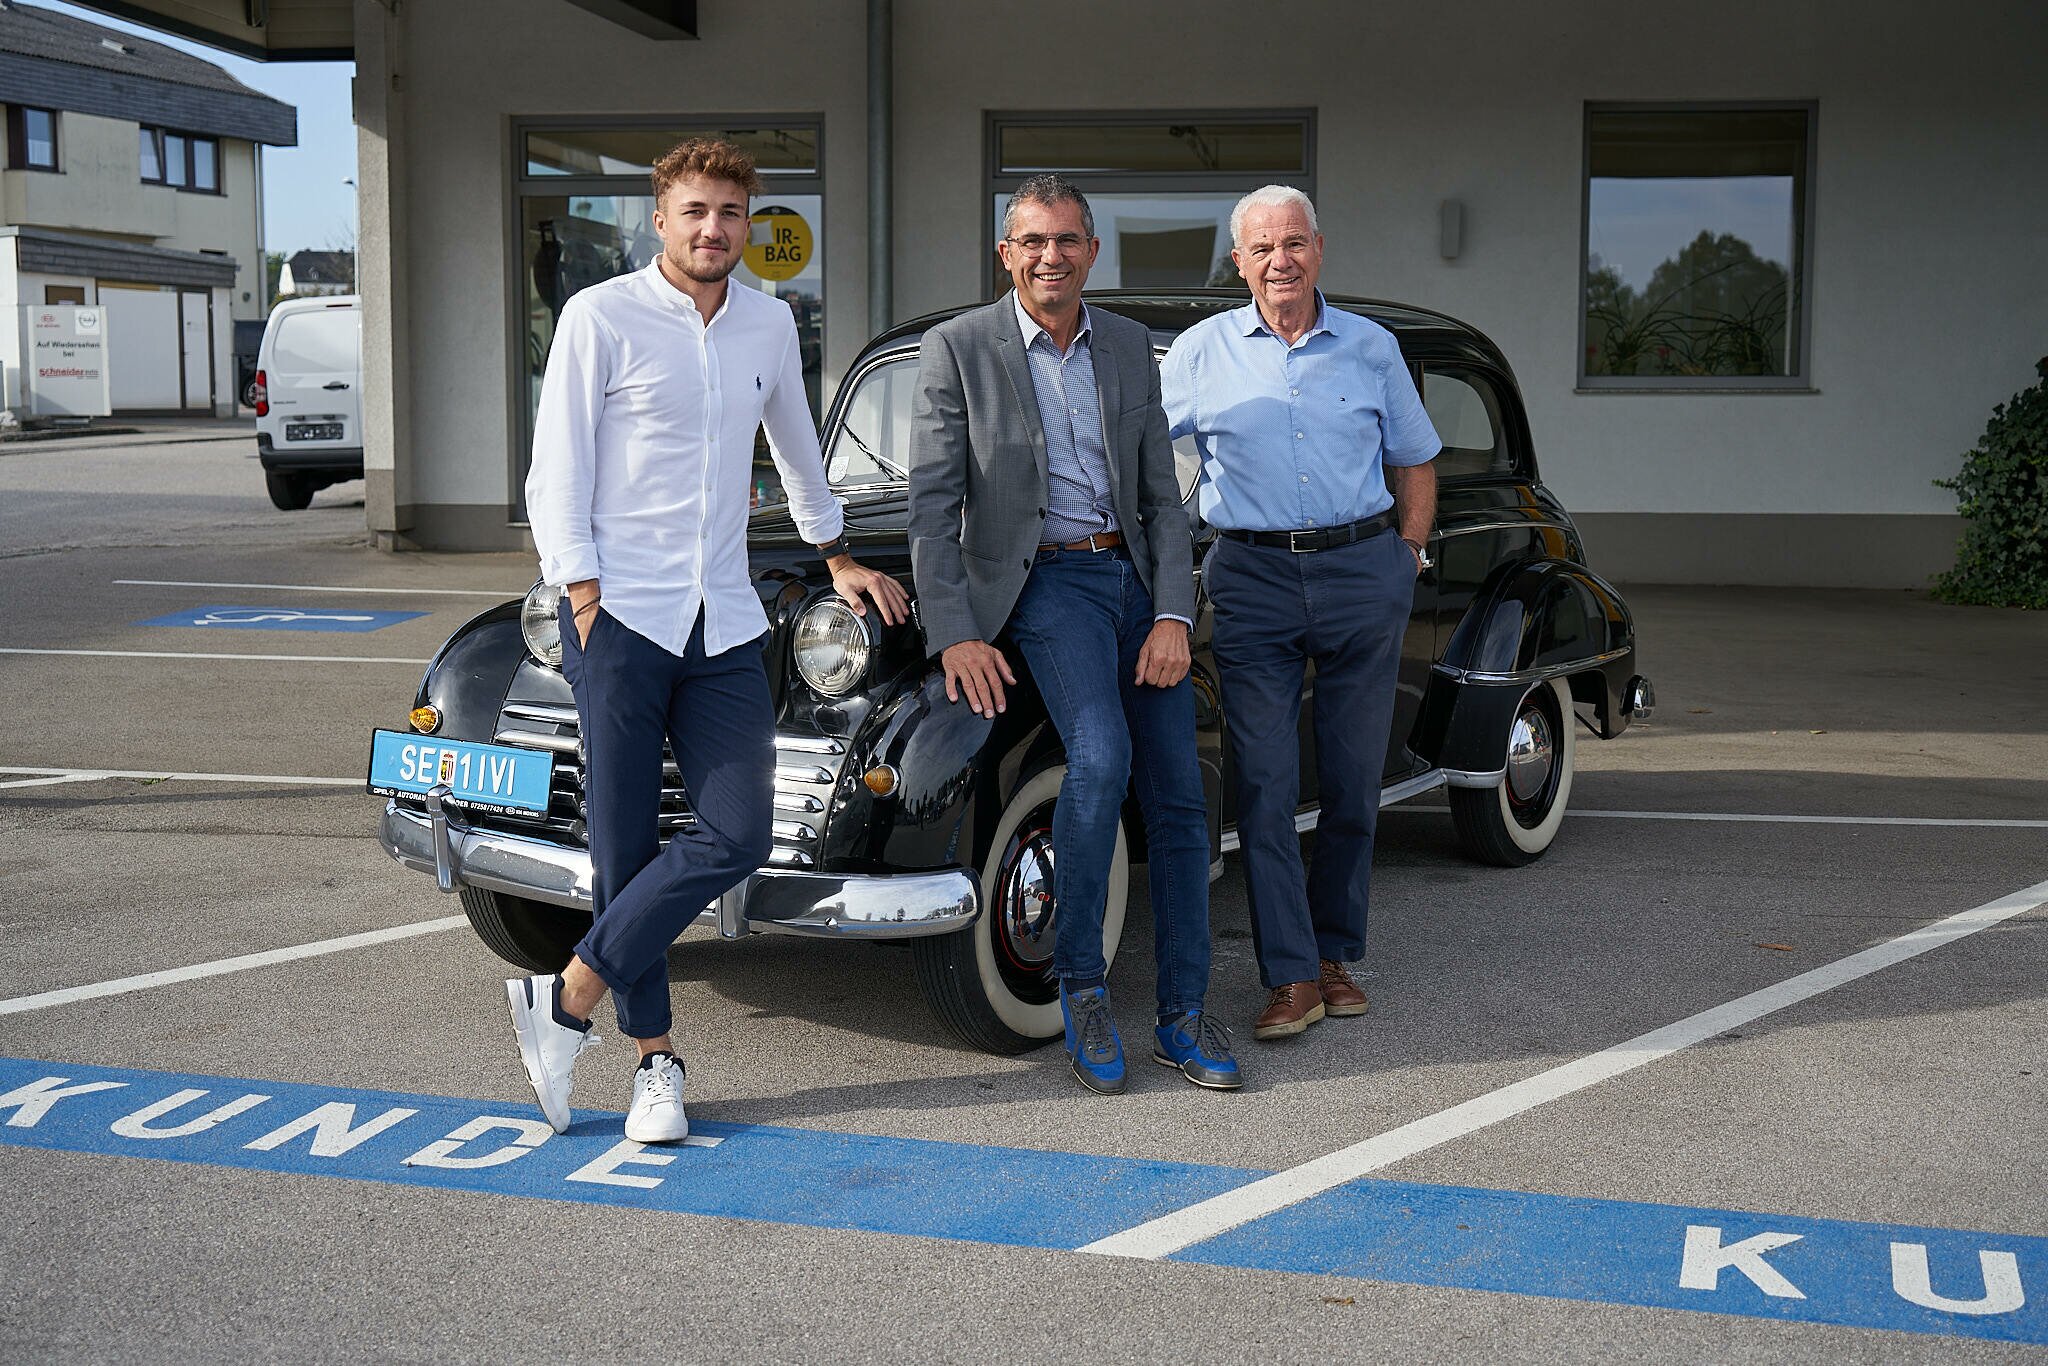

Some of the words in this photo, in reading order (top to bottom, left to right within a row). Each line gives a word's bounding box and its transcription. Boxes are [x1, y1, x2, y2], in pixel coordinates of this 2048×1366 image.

[765, 246, 801, 262] BAG
[400, 744, 437, 784] SE
[397, 791, 427, 801] AUTOHAU
[0, 1077, 723, 1189] KUNDE
[1679, 1225, 2026, 1315] KU
